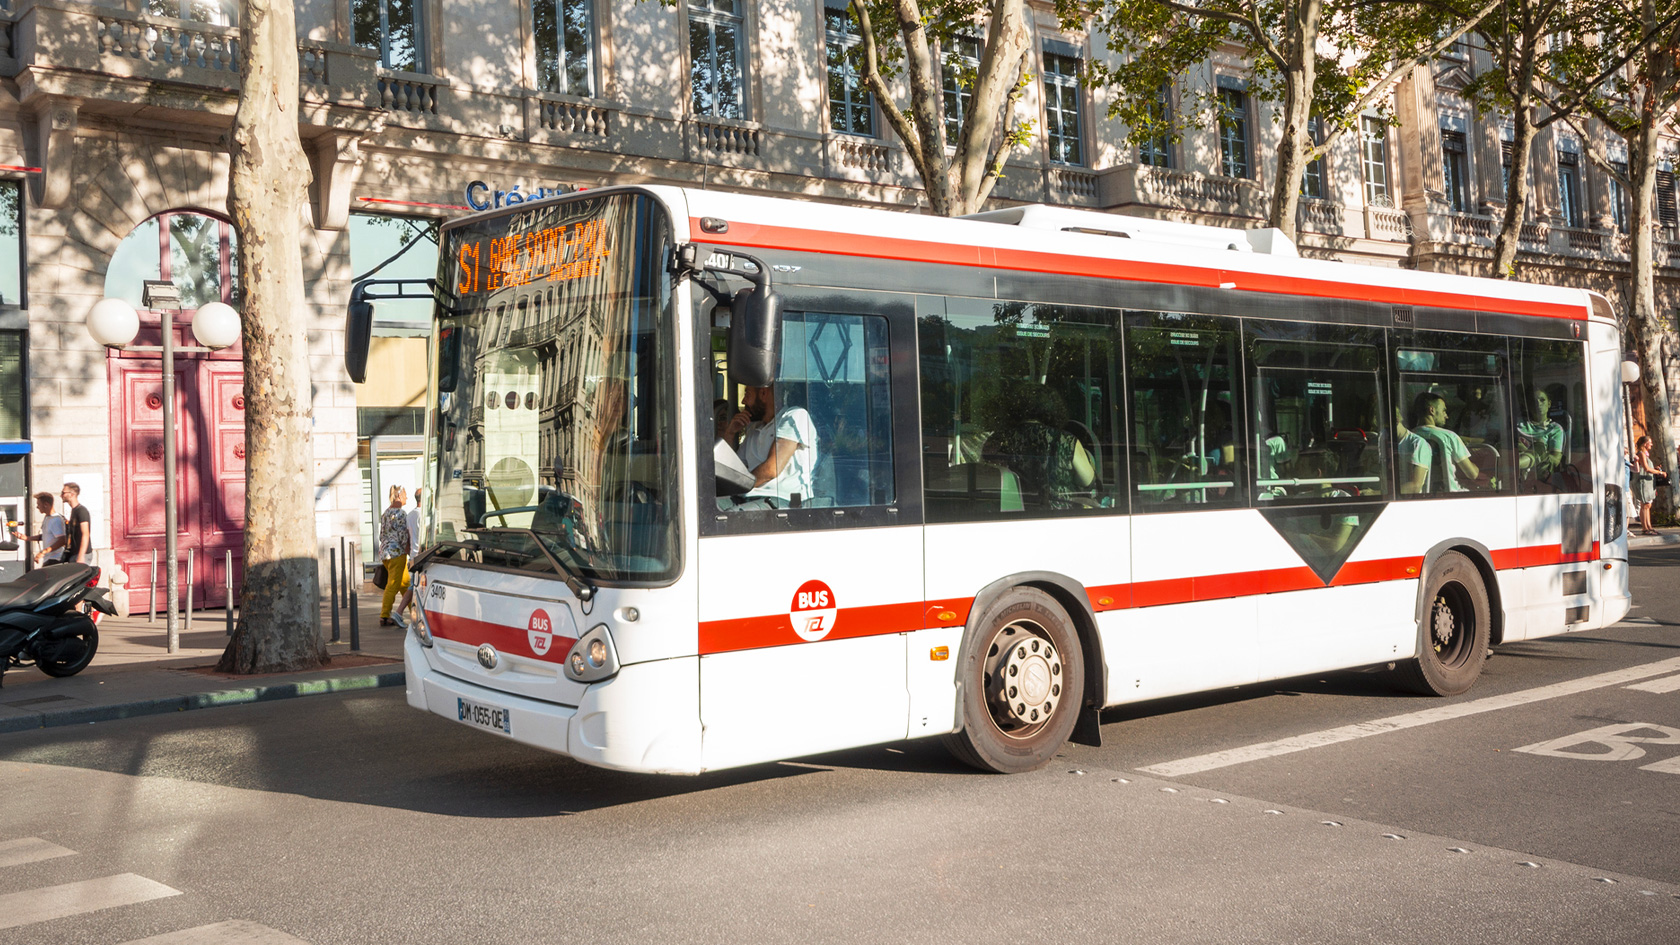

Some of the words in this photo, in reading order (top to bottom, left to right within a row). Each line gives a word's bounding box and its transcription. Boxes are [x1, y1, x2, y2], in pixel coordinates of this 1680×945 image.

[465, 180, 562, 211] Cré
[459, 241, 480, 294] S1
[489, 234, 522, 273] GARE
[526, 218, 610, 268] SAINT-PAUL
[704, 253, 735, 270] 408
[431, 584, 447, 600] 3408
[798, 590, 829, 609] BUS
[532, 617, 548, 631] BUS
[461, 702, 503, 729] DM-055-QE
